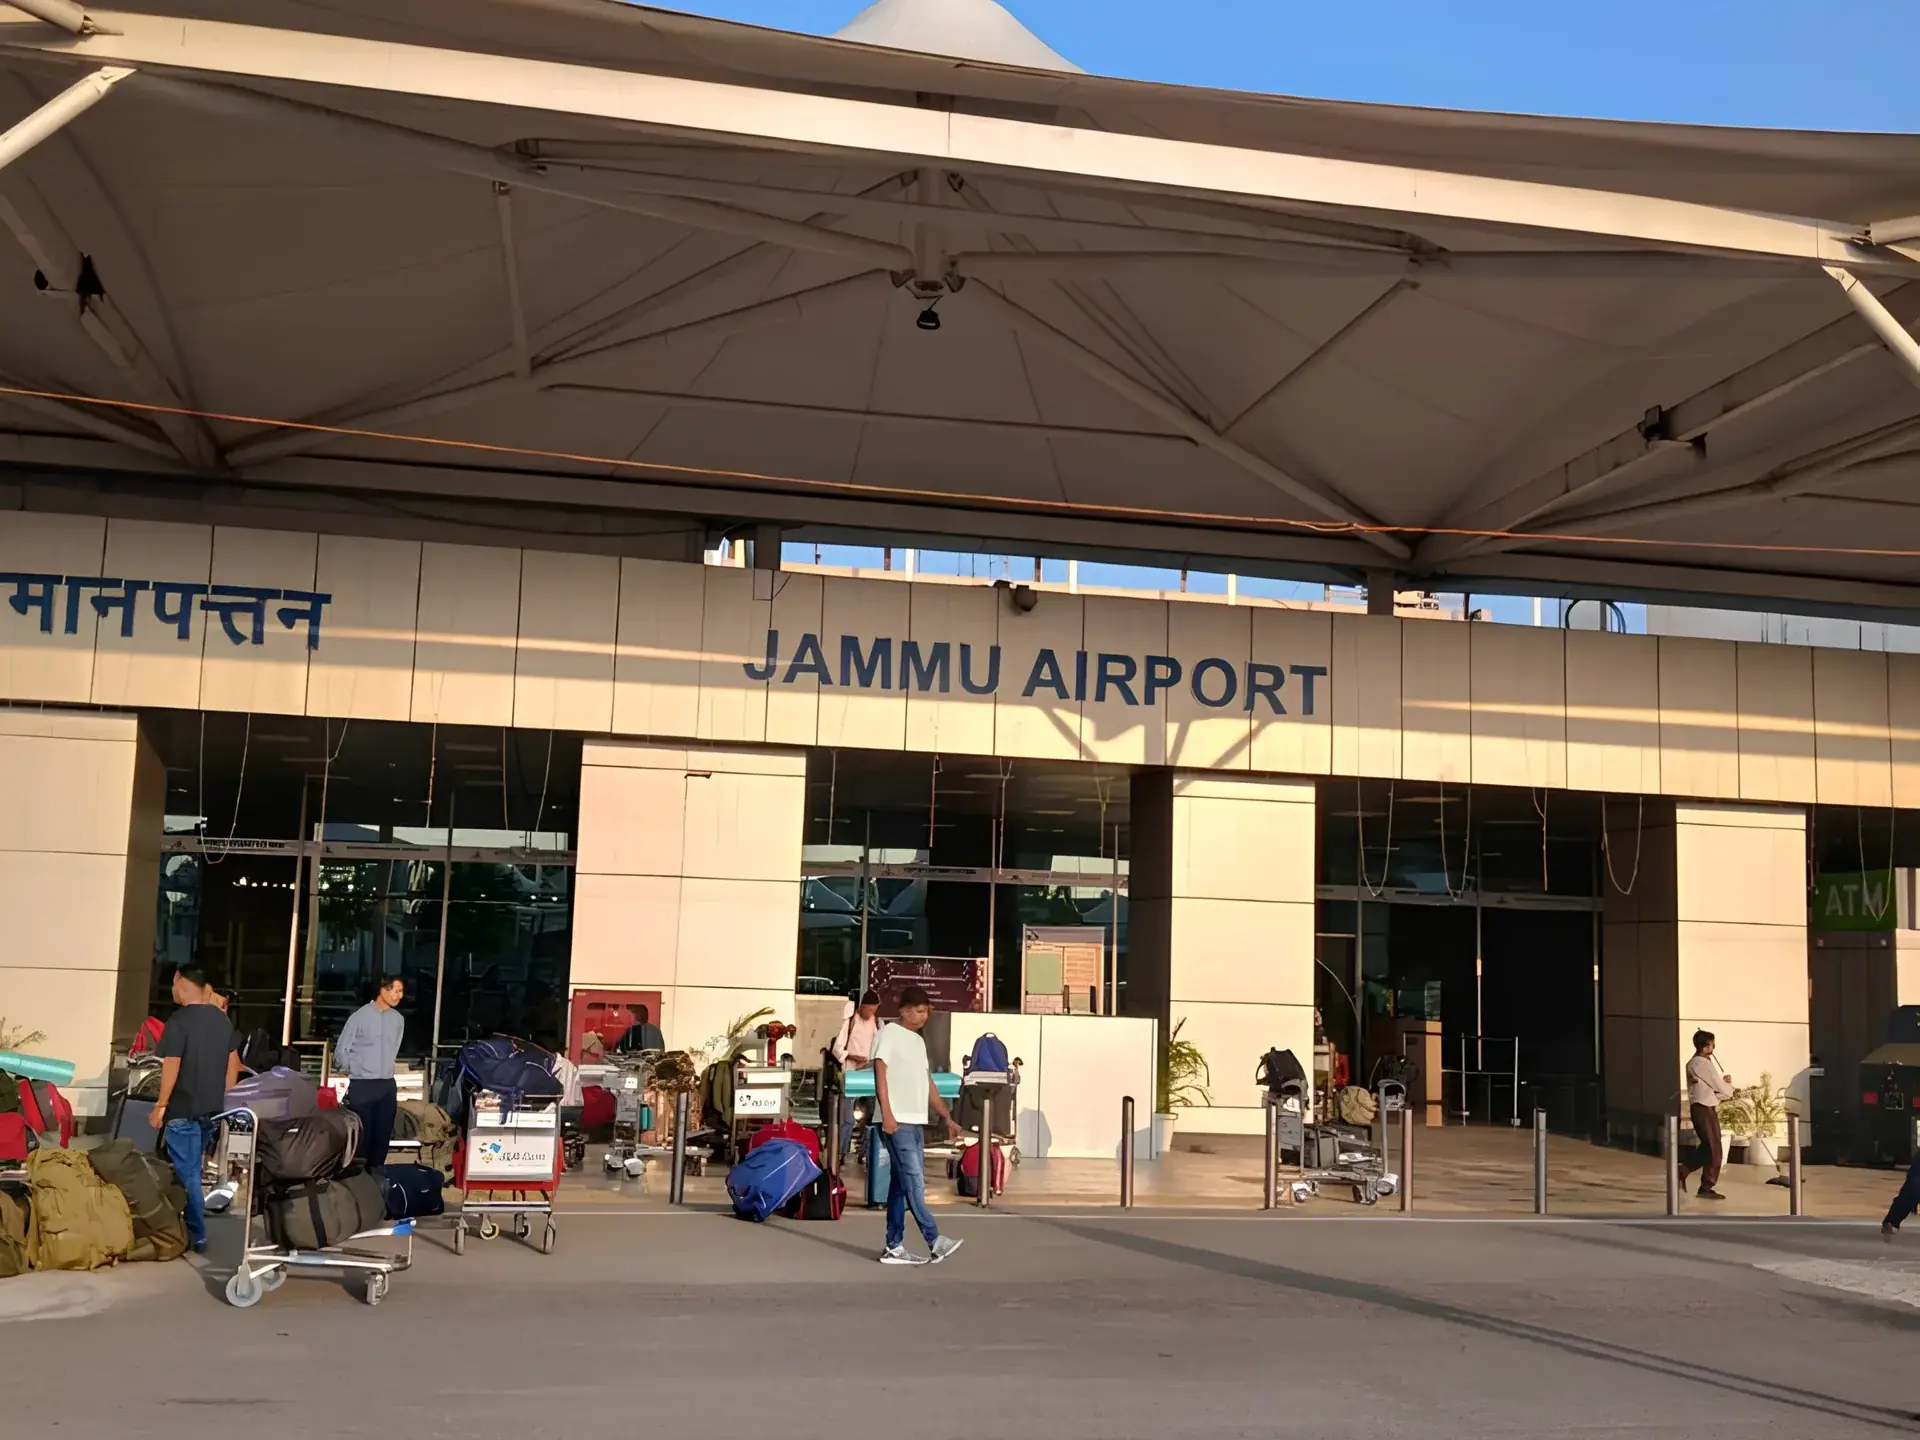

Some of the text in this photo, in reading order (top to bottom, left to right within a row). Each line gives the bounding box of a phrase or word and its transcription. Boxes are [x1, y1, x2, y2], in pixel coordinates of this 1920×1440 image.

[743, 630, 1328, 715] JAMMU AIRPORT
[1825, 882, 1884, 917] ATM
